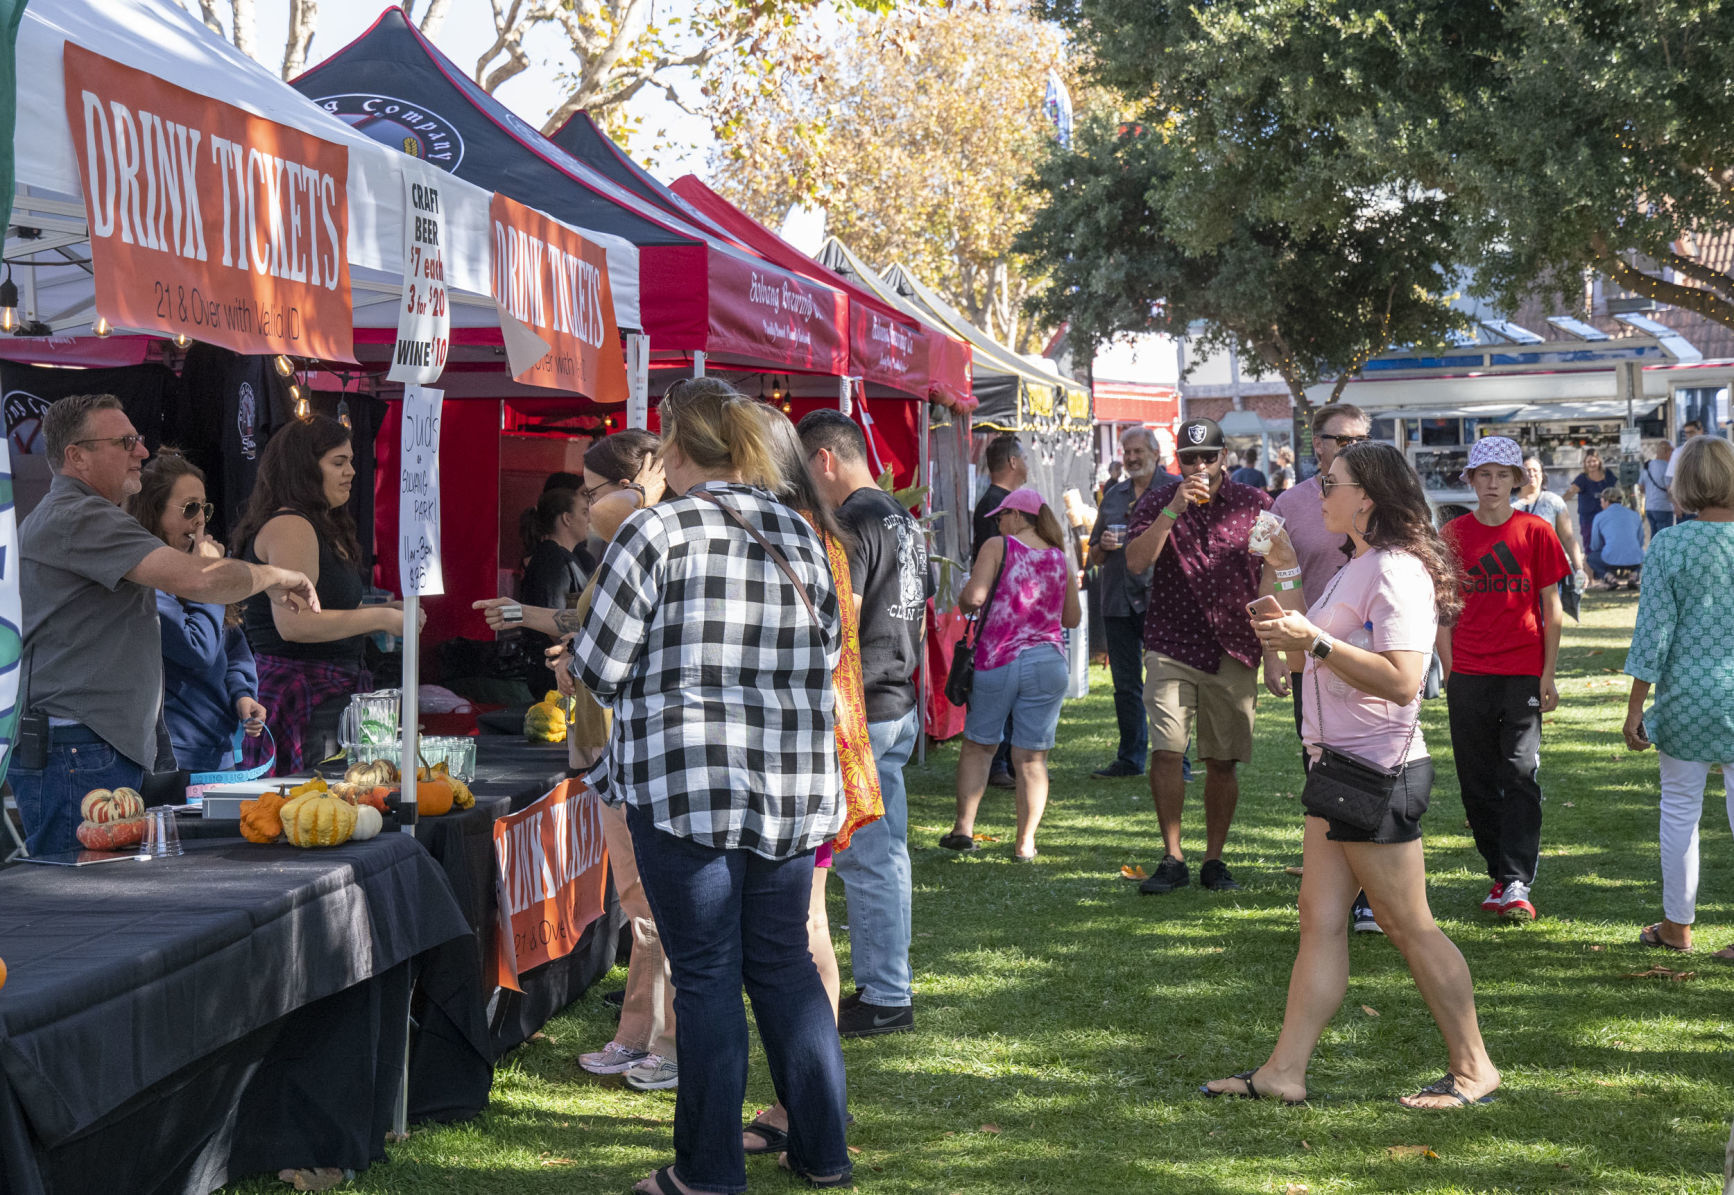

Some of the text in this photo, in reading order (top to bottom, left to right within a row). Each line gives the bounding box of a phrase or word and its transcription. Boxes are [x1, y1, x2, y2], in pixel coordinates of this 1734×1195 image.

[362, 98, 453, 162] Company
[82, 89, 340, 291] DRINK TICKETS
[411, 183, 439, 214] CRAFT
[415, 216, 439, 246] BEER
[410, 243, 444, 281] $7 each
[407, 284, 445, 318] 3 for $20
[495, 220, 605, 349] DRINK TICKETS
[750, 271, 780, 314] Solvang
[782, 280, 813, 323] Brewing
[154, 280, 300, 341] 21 & Over with Valid ID
[397, 334, 447, 367] WINE $10
[555, 351, 575, 376] with
[404, 393, 440, 454] Suds
[414, 498, 437, 524] PARK!
[1462, 574, 1531, 594] adidas
